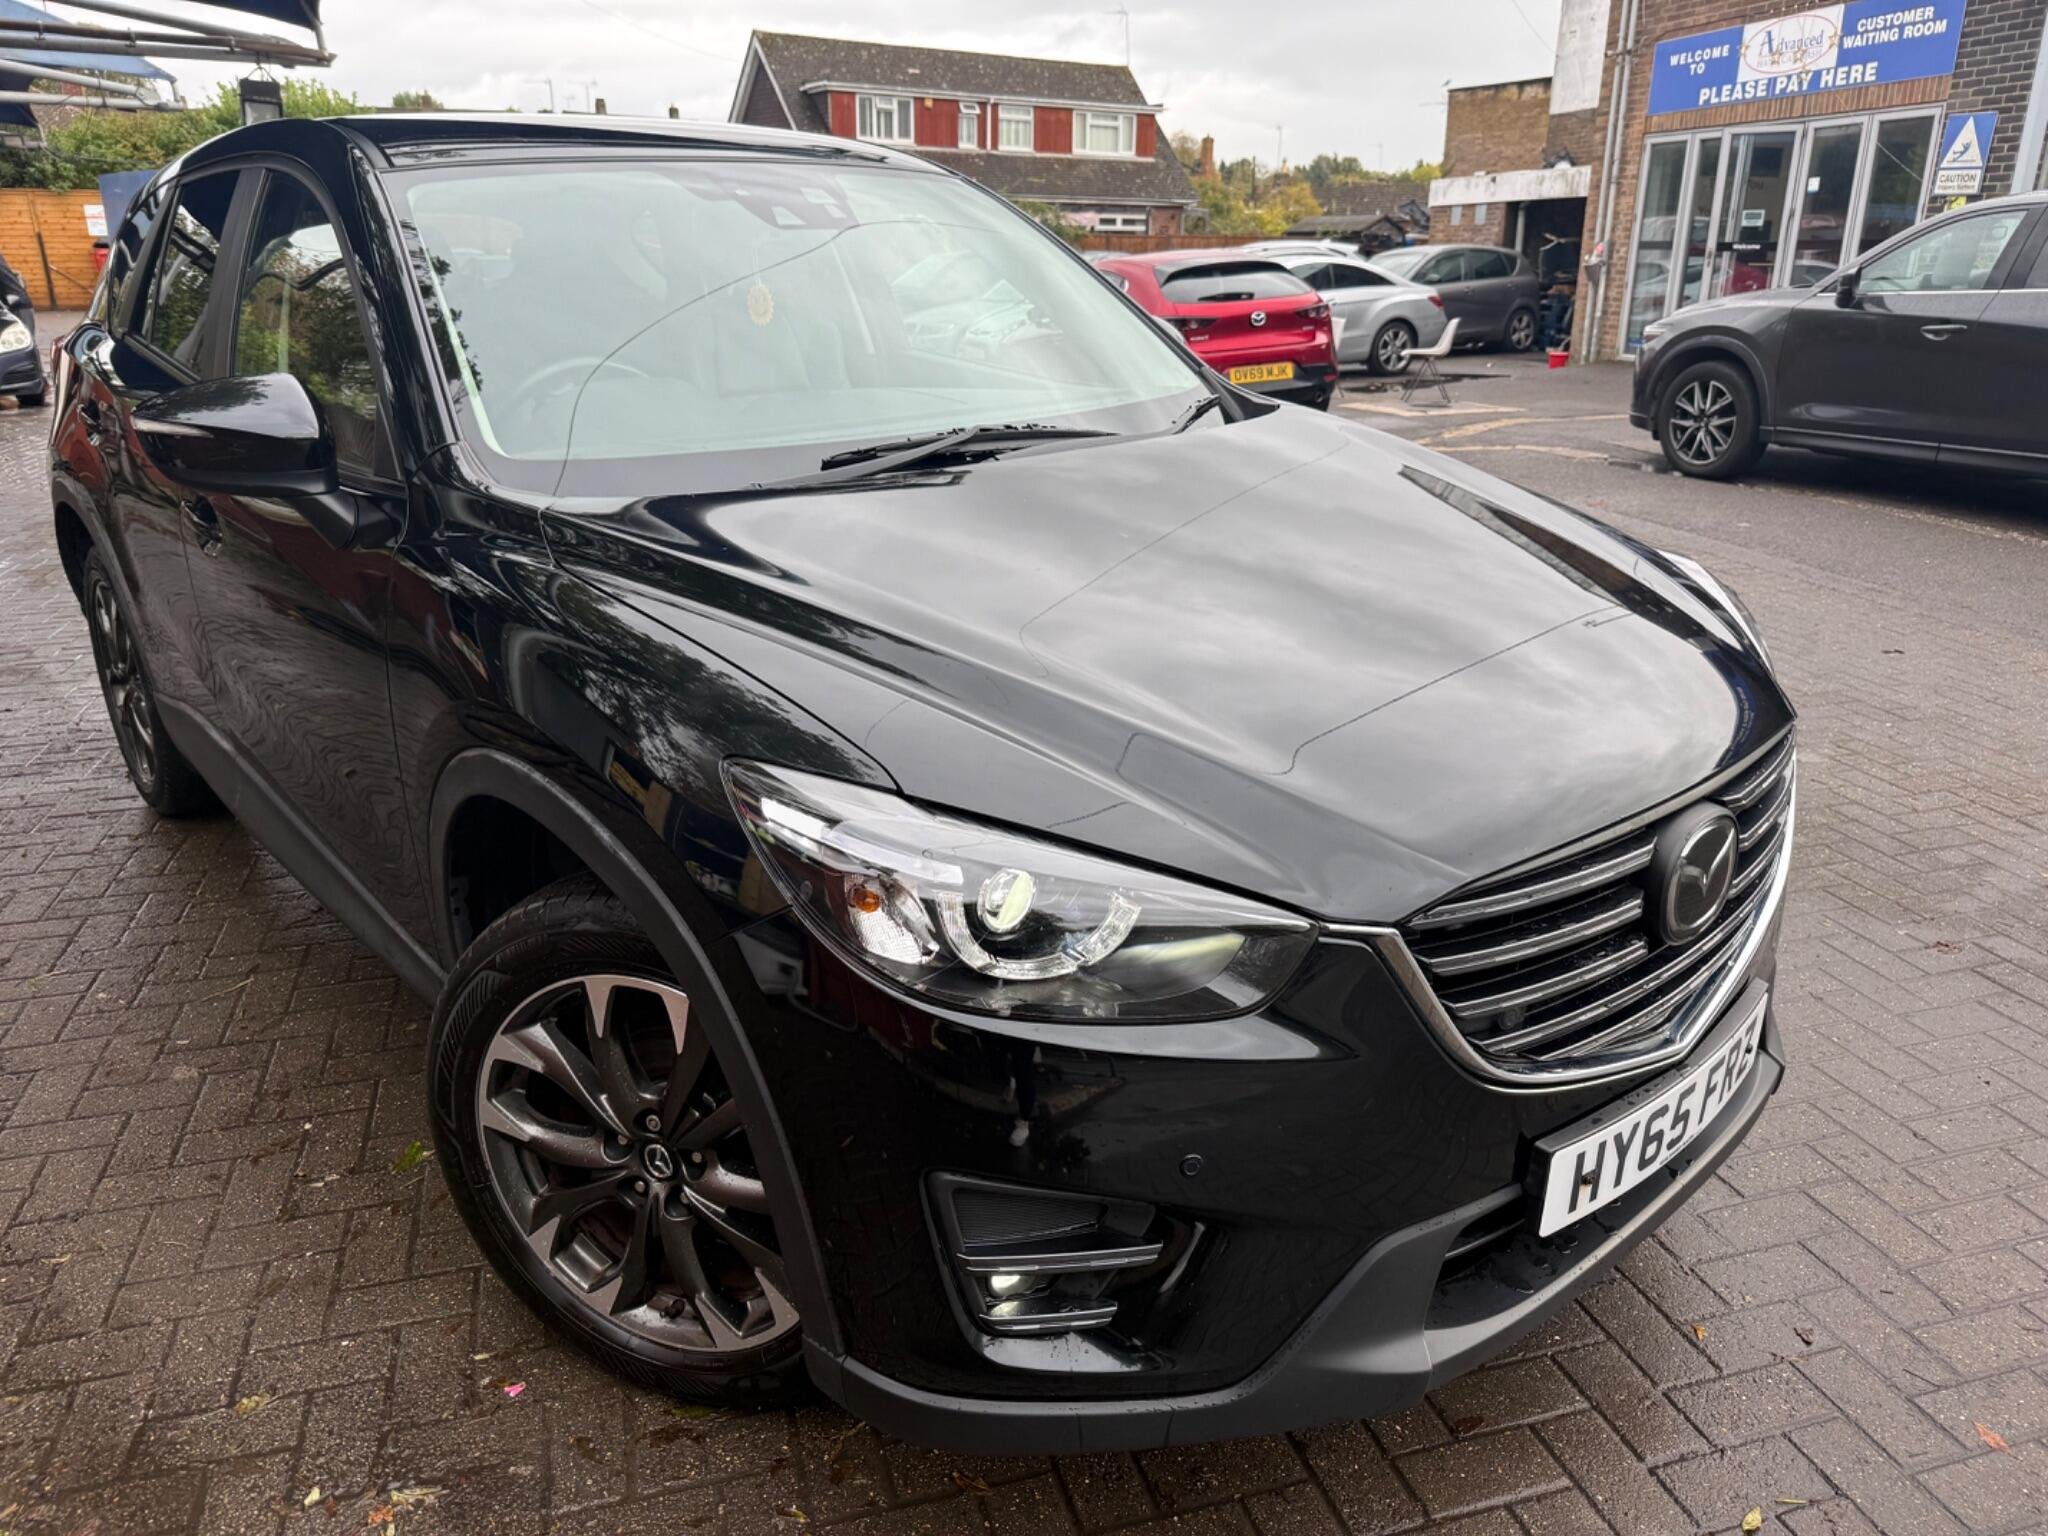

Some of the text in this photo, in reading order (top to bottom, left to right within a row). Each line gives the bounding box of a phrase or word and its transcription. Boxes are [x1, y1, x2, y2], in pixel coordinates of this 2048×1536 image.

[1857, 6, 1935, 32] CUSTOMER
[1759, 29, 1824, 56] Advanced
[1843, 19, 1947, 49] WAITING ROOM
[1670, 44, 1730, 66] WELCOME
[1690, 62, 1705, 76] TO
[1698, 61, 1878, 106] PLEASE PAY HERE
[1940, 173, 1977, 183] CAUTION
[1568, 1081, 1697, 1215] HY65
